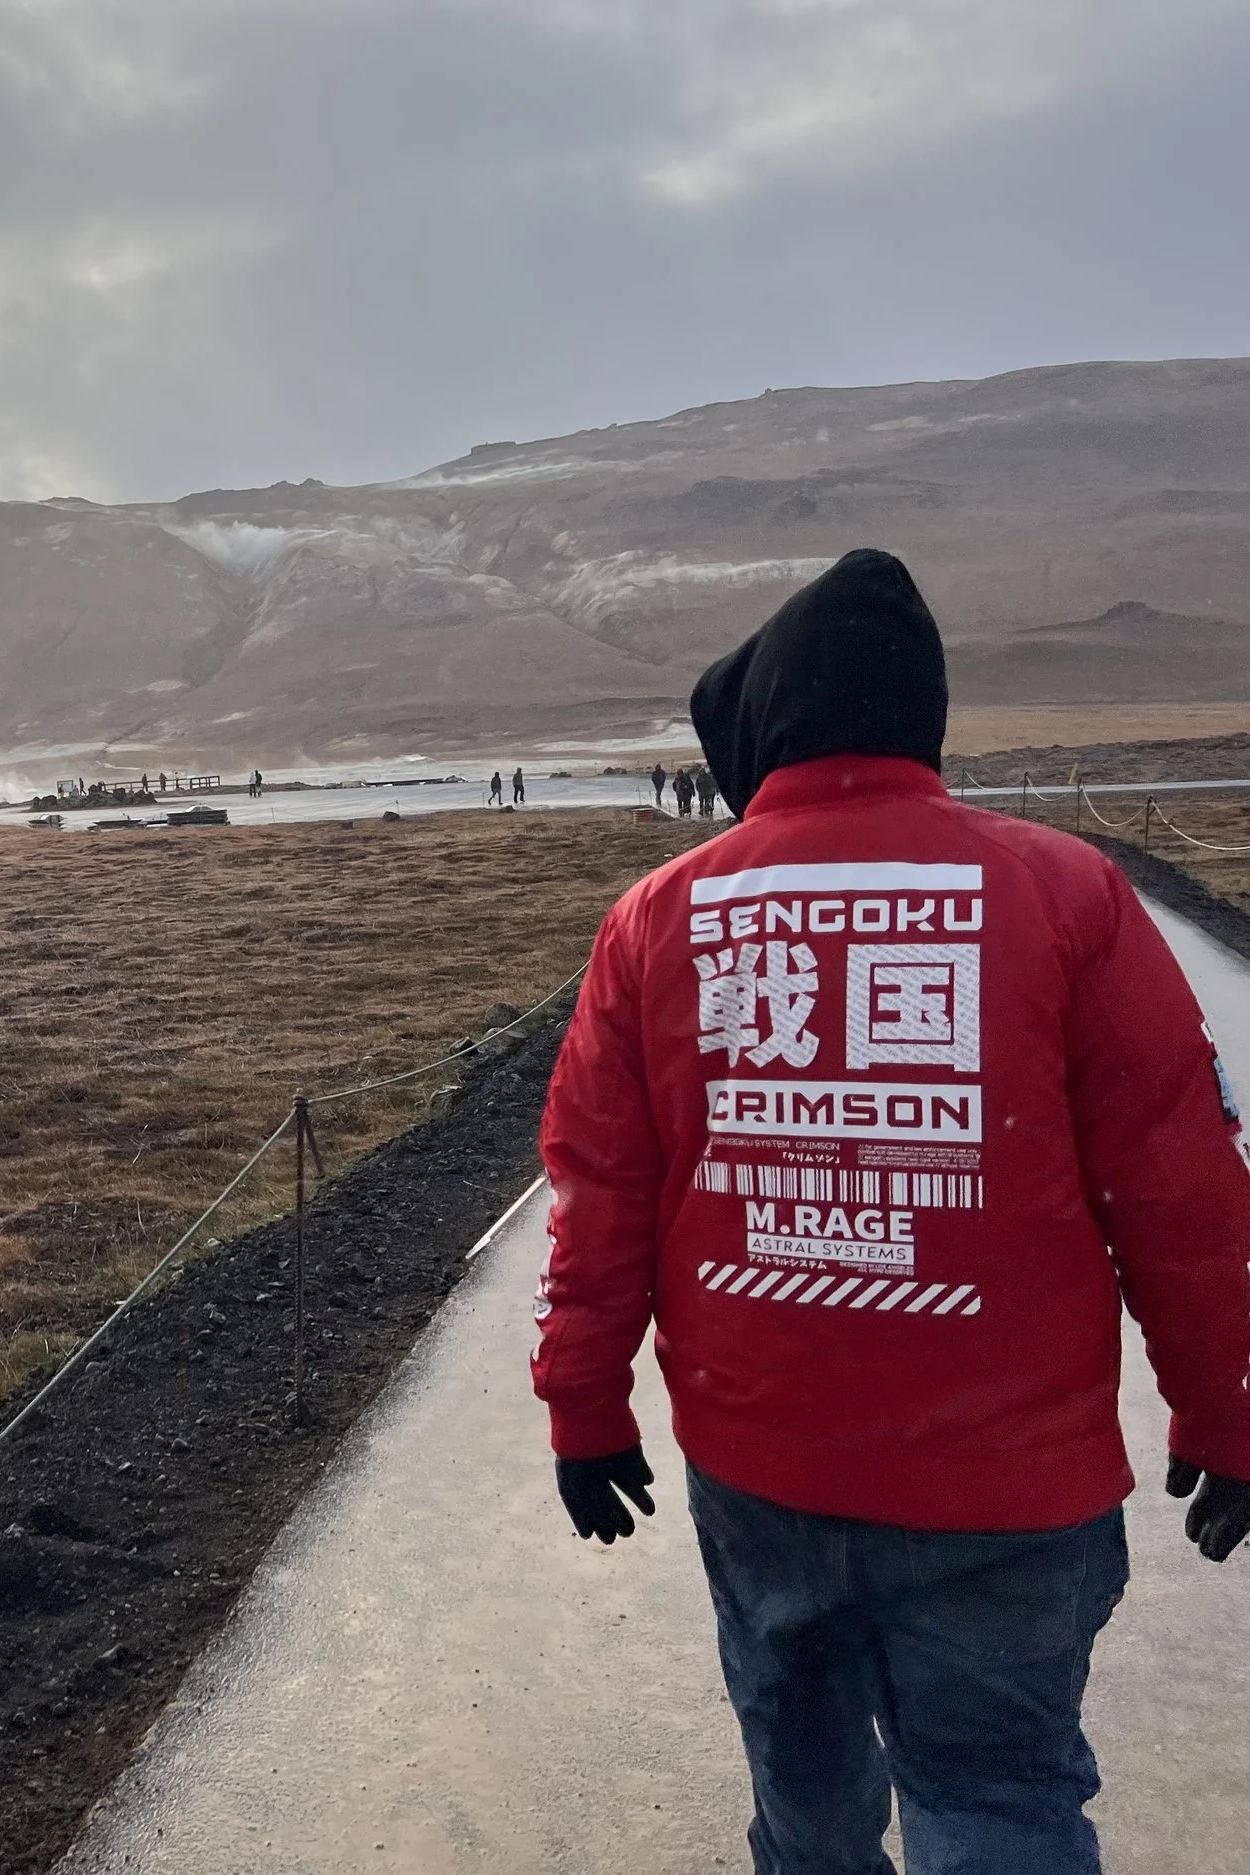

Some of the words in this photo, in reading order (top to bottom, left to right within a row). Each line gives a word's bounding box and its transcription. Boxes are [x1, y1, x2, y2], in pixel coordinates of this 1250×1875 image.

[690, 898, 983, 944] SENGOKU
[692, 940, 981, 1073] 戦国
[710, 1090, 970, 1130] CRIMSON
[754, 1139, 790, 1148] SYSTEM
[795, 1141, 840, 1150] CRIMSON
[745, 1201, 914, 1243] M.RAGE
[752, 1238, 817, 1255] ASTRAL
[822, 1243, 907, 1261] SYSTEMS
